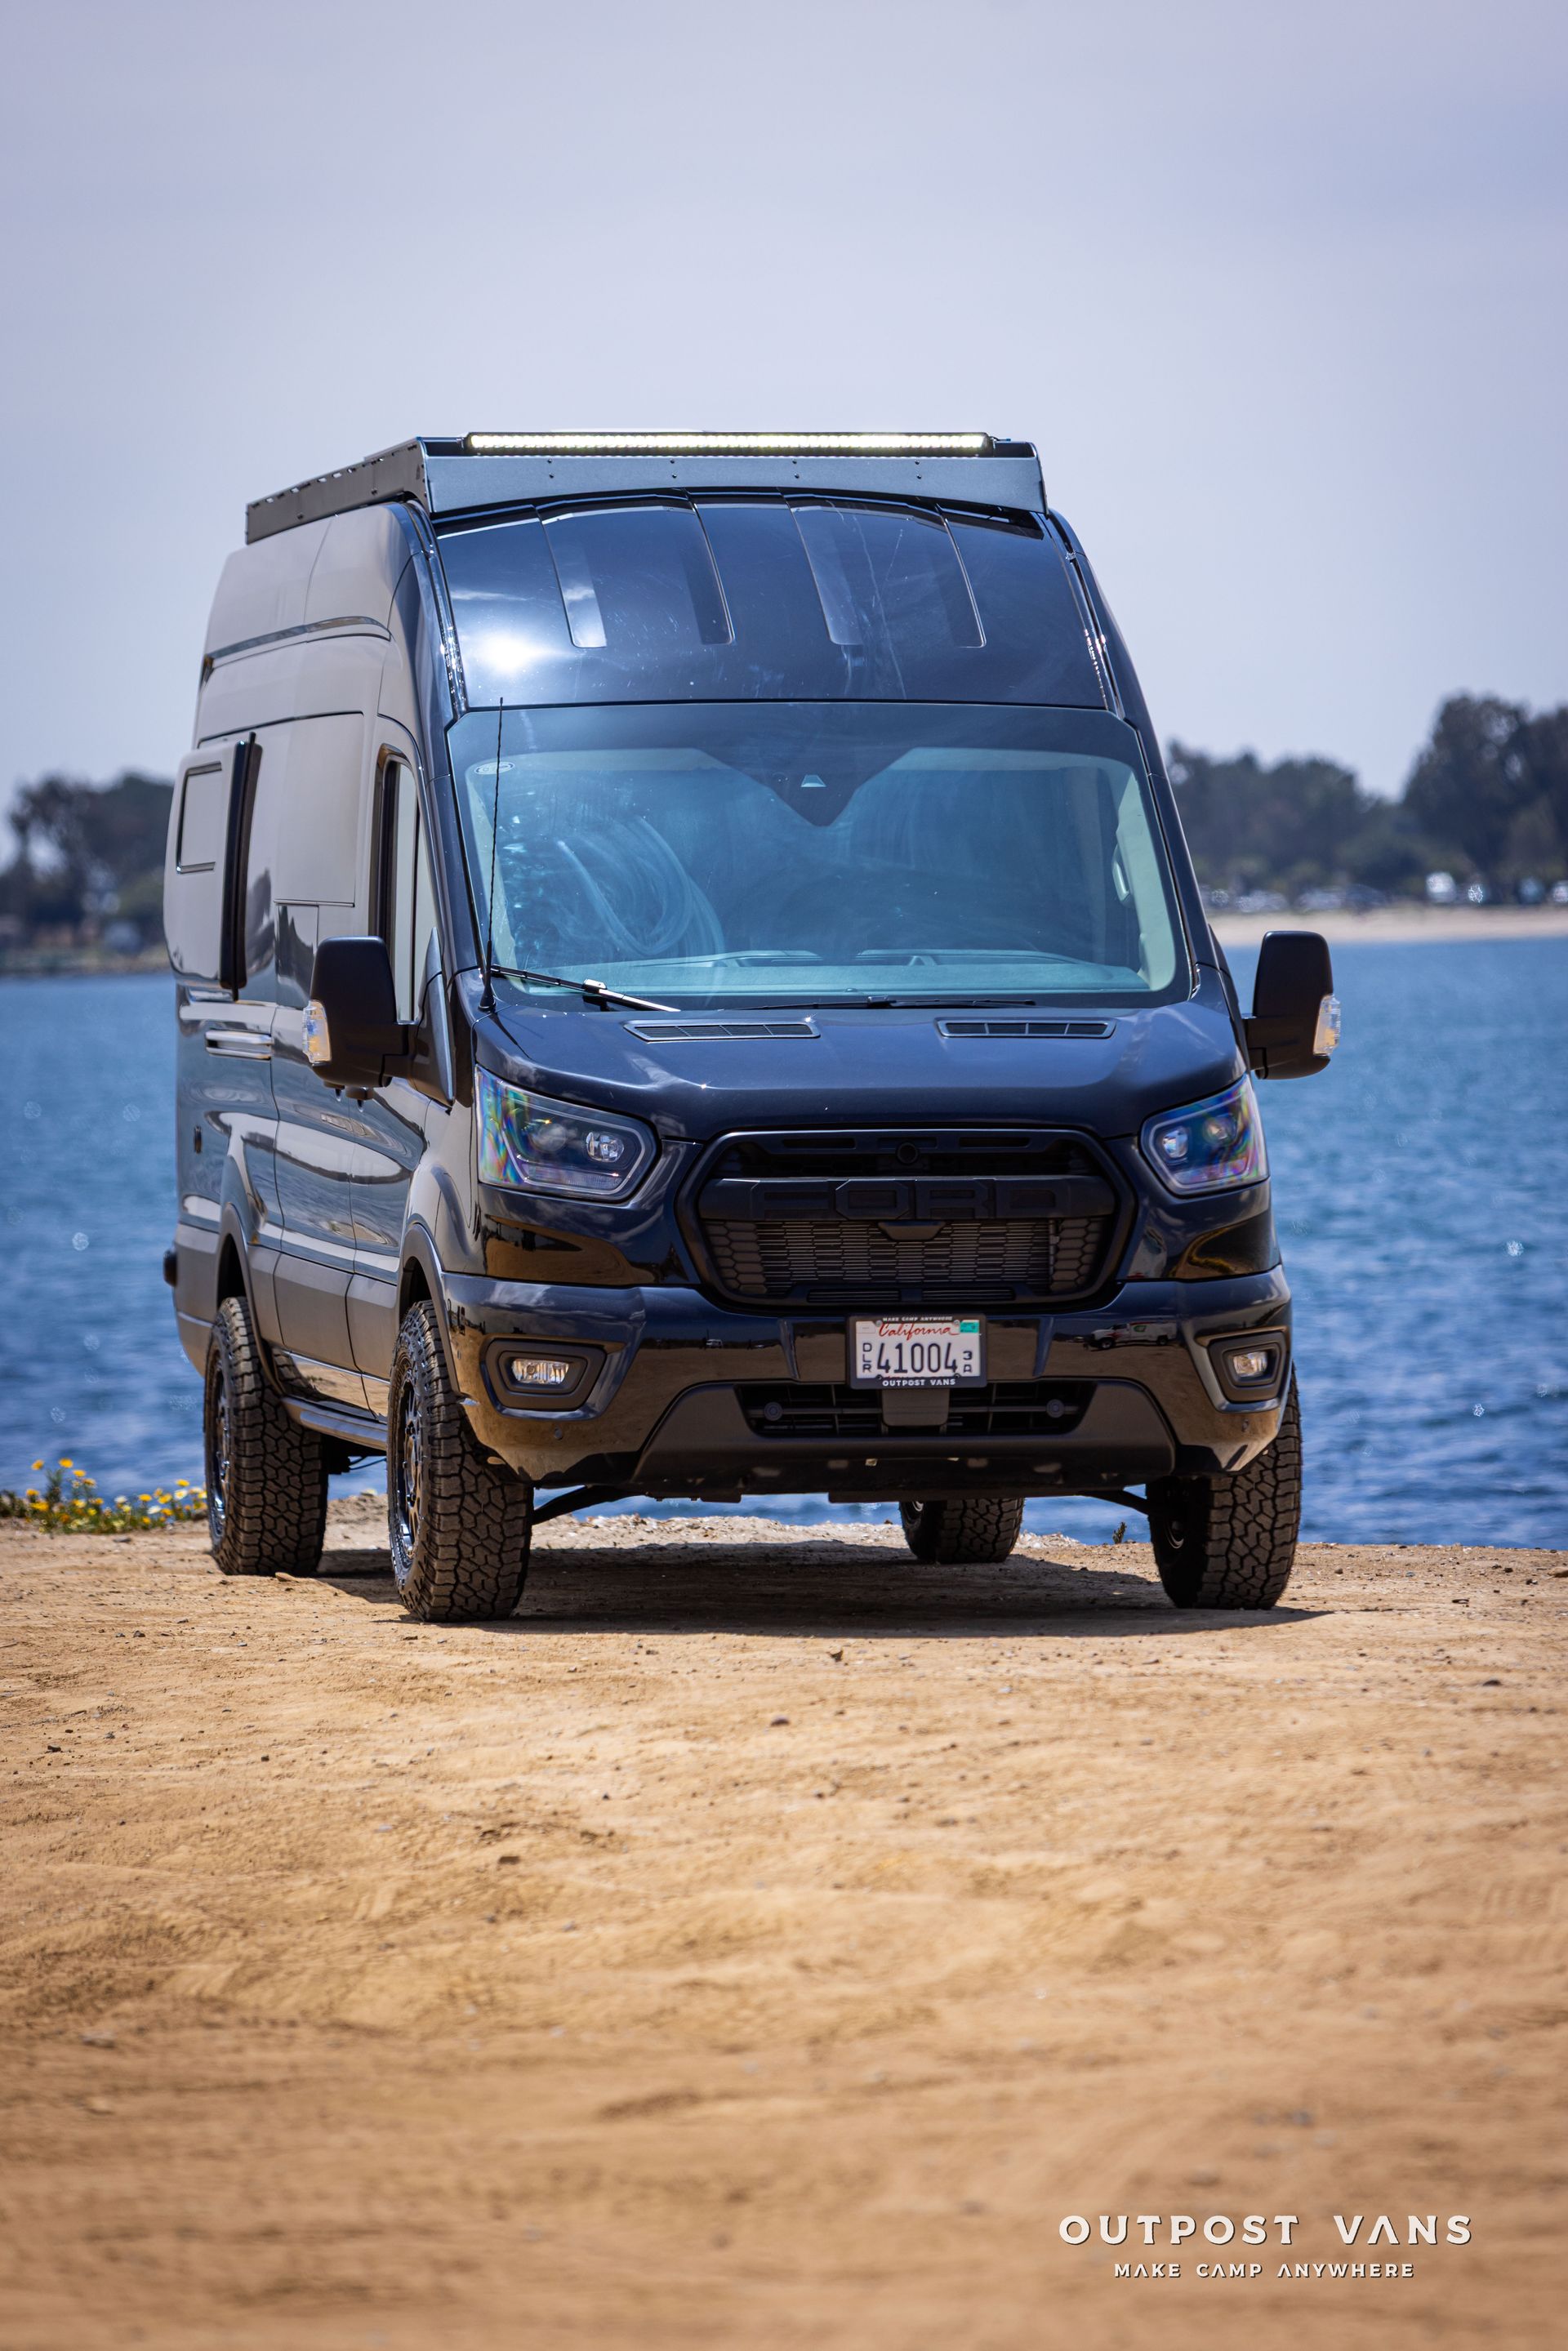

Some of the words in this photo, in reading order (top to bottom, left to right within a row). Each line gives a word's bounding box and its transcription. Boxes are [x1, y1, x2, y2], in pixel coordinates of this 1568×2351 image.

[751, 1178, 1071, 1220] FORD
[879, 1322, 960, 1340] California
[877, 1342, 957, 1374] 41004
